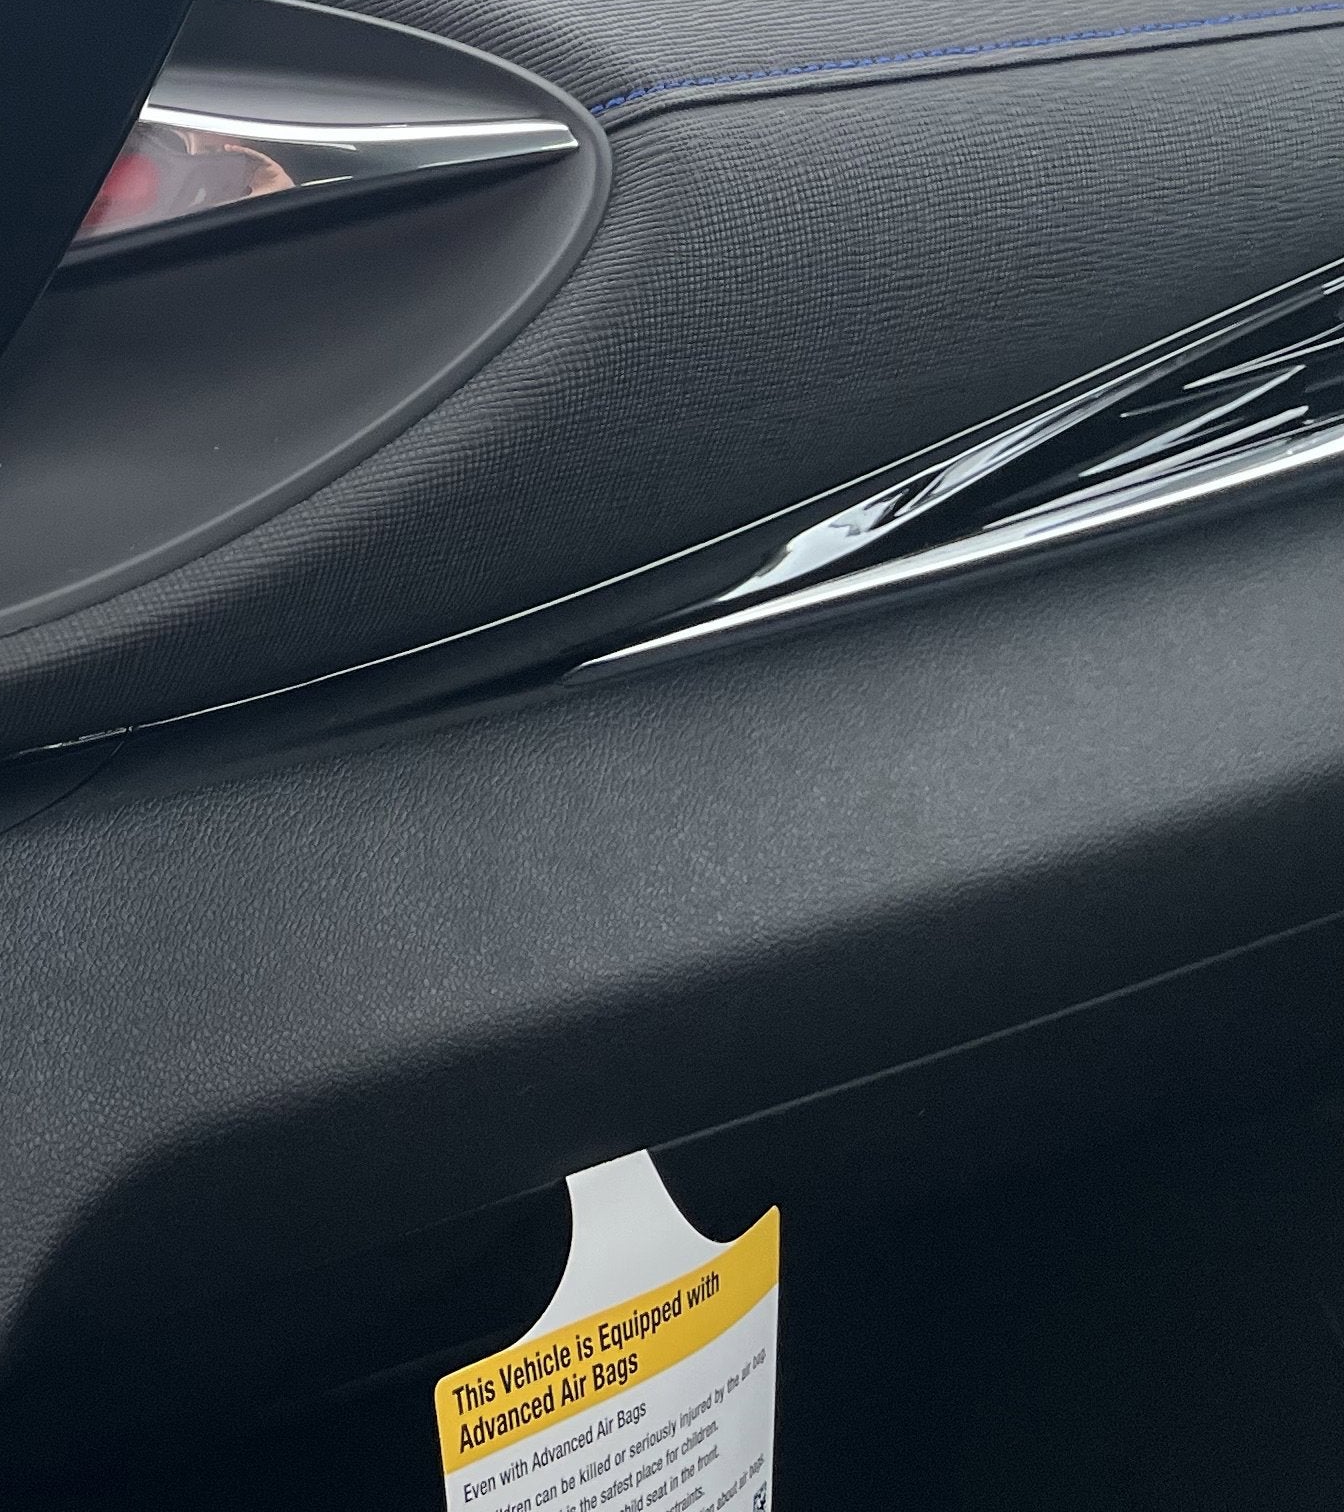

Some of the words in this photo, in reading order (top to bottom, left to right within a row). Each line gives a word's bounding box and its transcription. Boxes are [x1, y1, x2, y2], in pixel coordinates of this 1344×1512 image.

[452, 1377, 496, 1416] This
[499, 1344, 571, 1394] Vehicle
[575, 1334, 594, 1361] is
[598, 1290, 681, 1352] Equipped
[687, 1271, 720, 1309] with
[459, 1385, 555, 1454] Advanced
[561, 1373, 587, 1407] Air
[592, 1353, 639, 1392] Bags
[463, 1476, 496, 1503] Even
[499, 1459, 529, 1486] with
[532, 1426, 593, 1472] Advanced
[597, 1417, 614, 1440] Air
[617, 1402, 647, 1429] Bags
[535, 1484, 558, 1507] can
[561, 1475, 576, 1494] be
[579, 1454, 611, 1485] killed
[614, 1450, 627, 1466] or
[630, 1418, 677, 1459] seriously
[679, 1393, 712, 1428] injured
[714, 1386, 725, 1404] by
[727, 1374, 740, 1394] the
[579, 1496, 598, 1512] the
[600, 1472, 634, 1504] safest
[636, 1458, 663, 1488] place
[666, 1446, 680, 1466] for
[646, 1482, 668, 1507] seat
[670, 1475, 679, 1492] in
[681, 1464, 695, 1484] the
